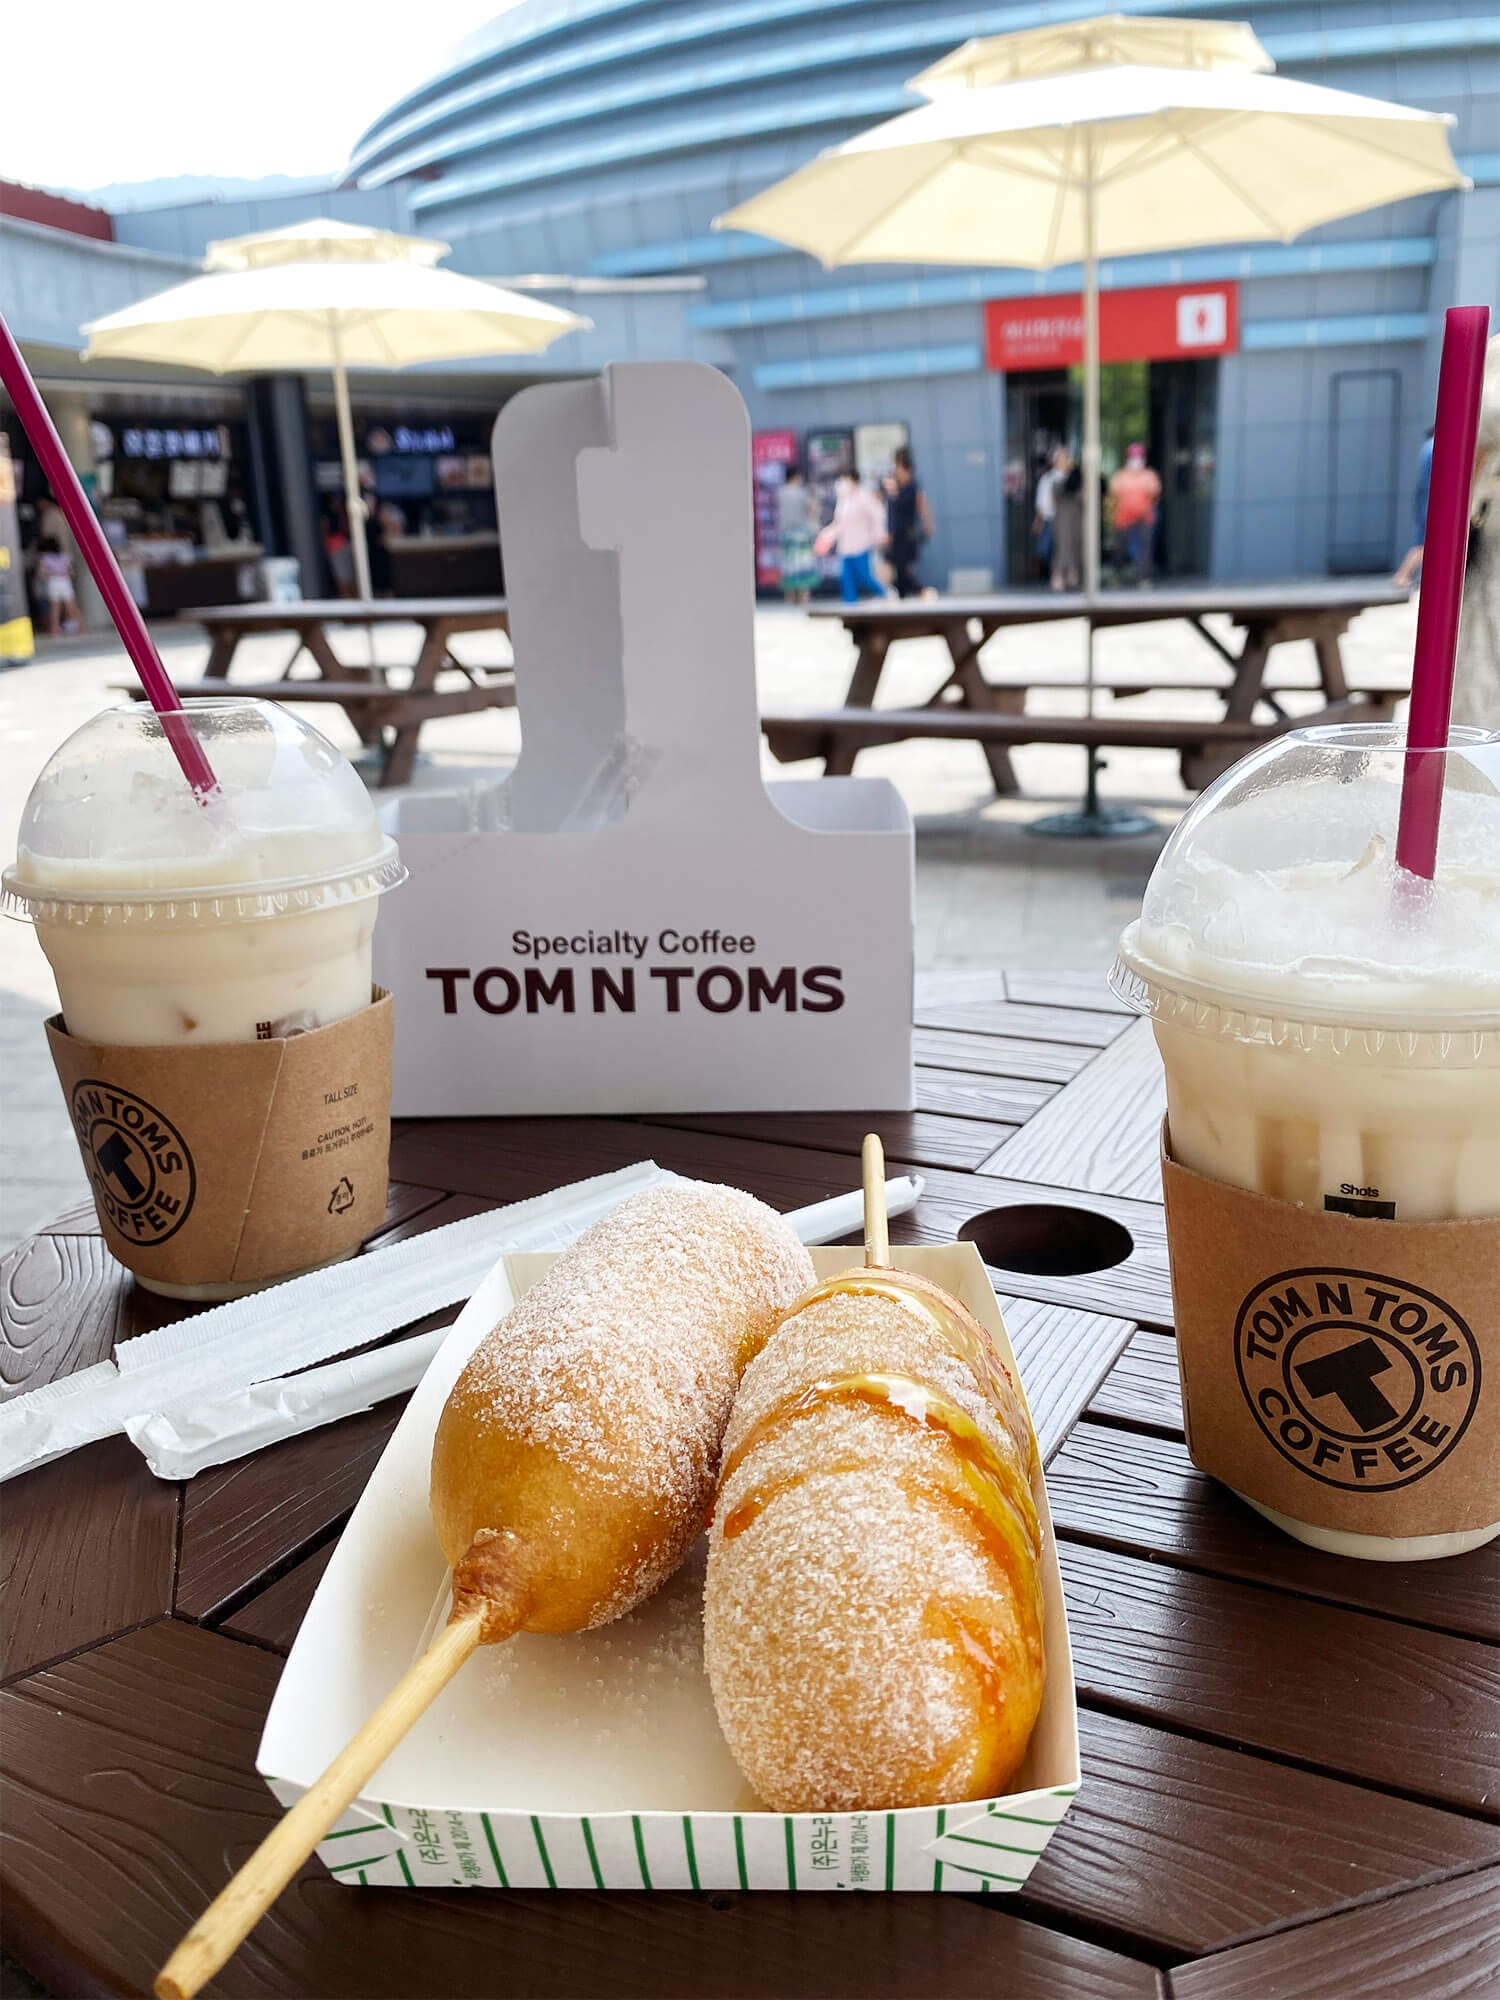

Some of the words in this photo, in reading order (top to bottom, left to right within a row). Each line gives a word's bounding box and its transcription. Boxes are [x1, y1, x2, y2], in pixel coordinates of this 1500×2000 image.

[512, 929, 649, 960] Specialty
[658, 929, 756, 954] Coffee
[425, 967, 576, 1014] TOM
[591, 967, 637, 1013] N
[650, 965, 845, 1013] TOMS
[324, 1090, 343, 1105] TALL
[343, 1083, 359, 1099] SIZE
[104, 1093, 183, 1175] TOMS
[93, 1169, 182, 1236] COFFEE
[1340, 1183, 1380, 1198] Shots
[1246, 1286, 1314, 1362] TOM
[1315, 1282, 1353, 1315] N
[1364, 1287, 1468, 1393] TOMS
[1257, 1387, 1451, 1479] COFFEE
